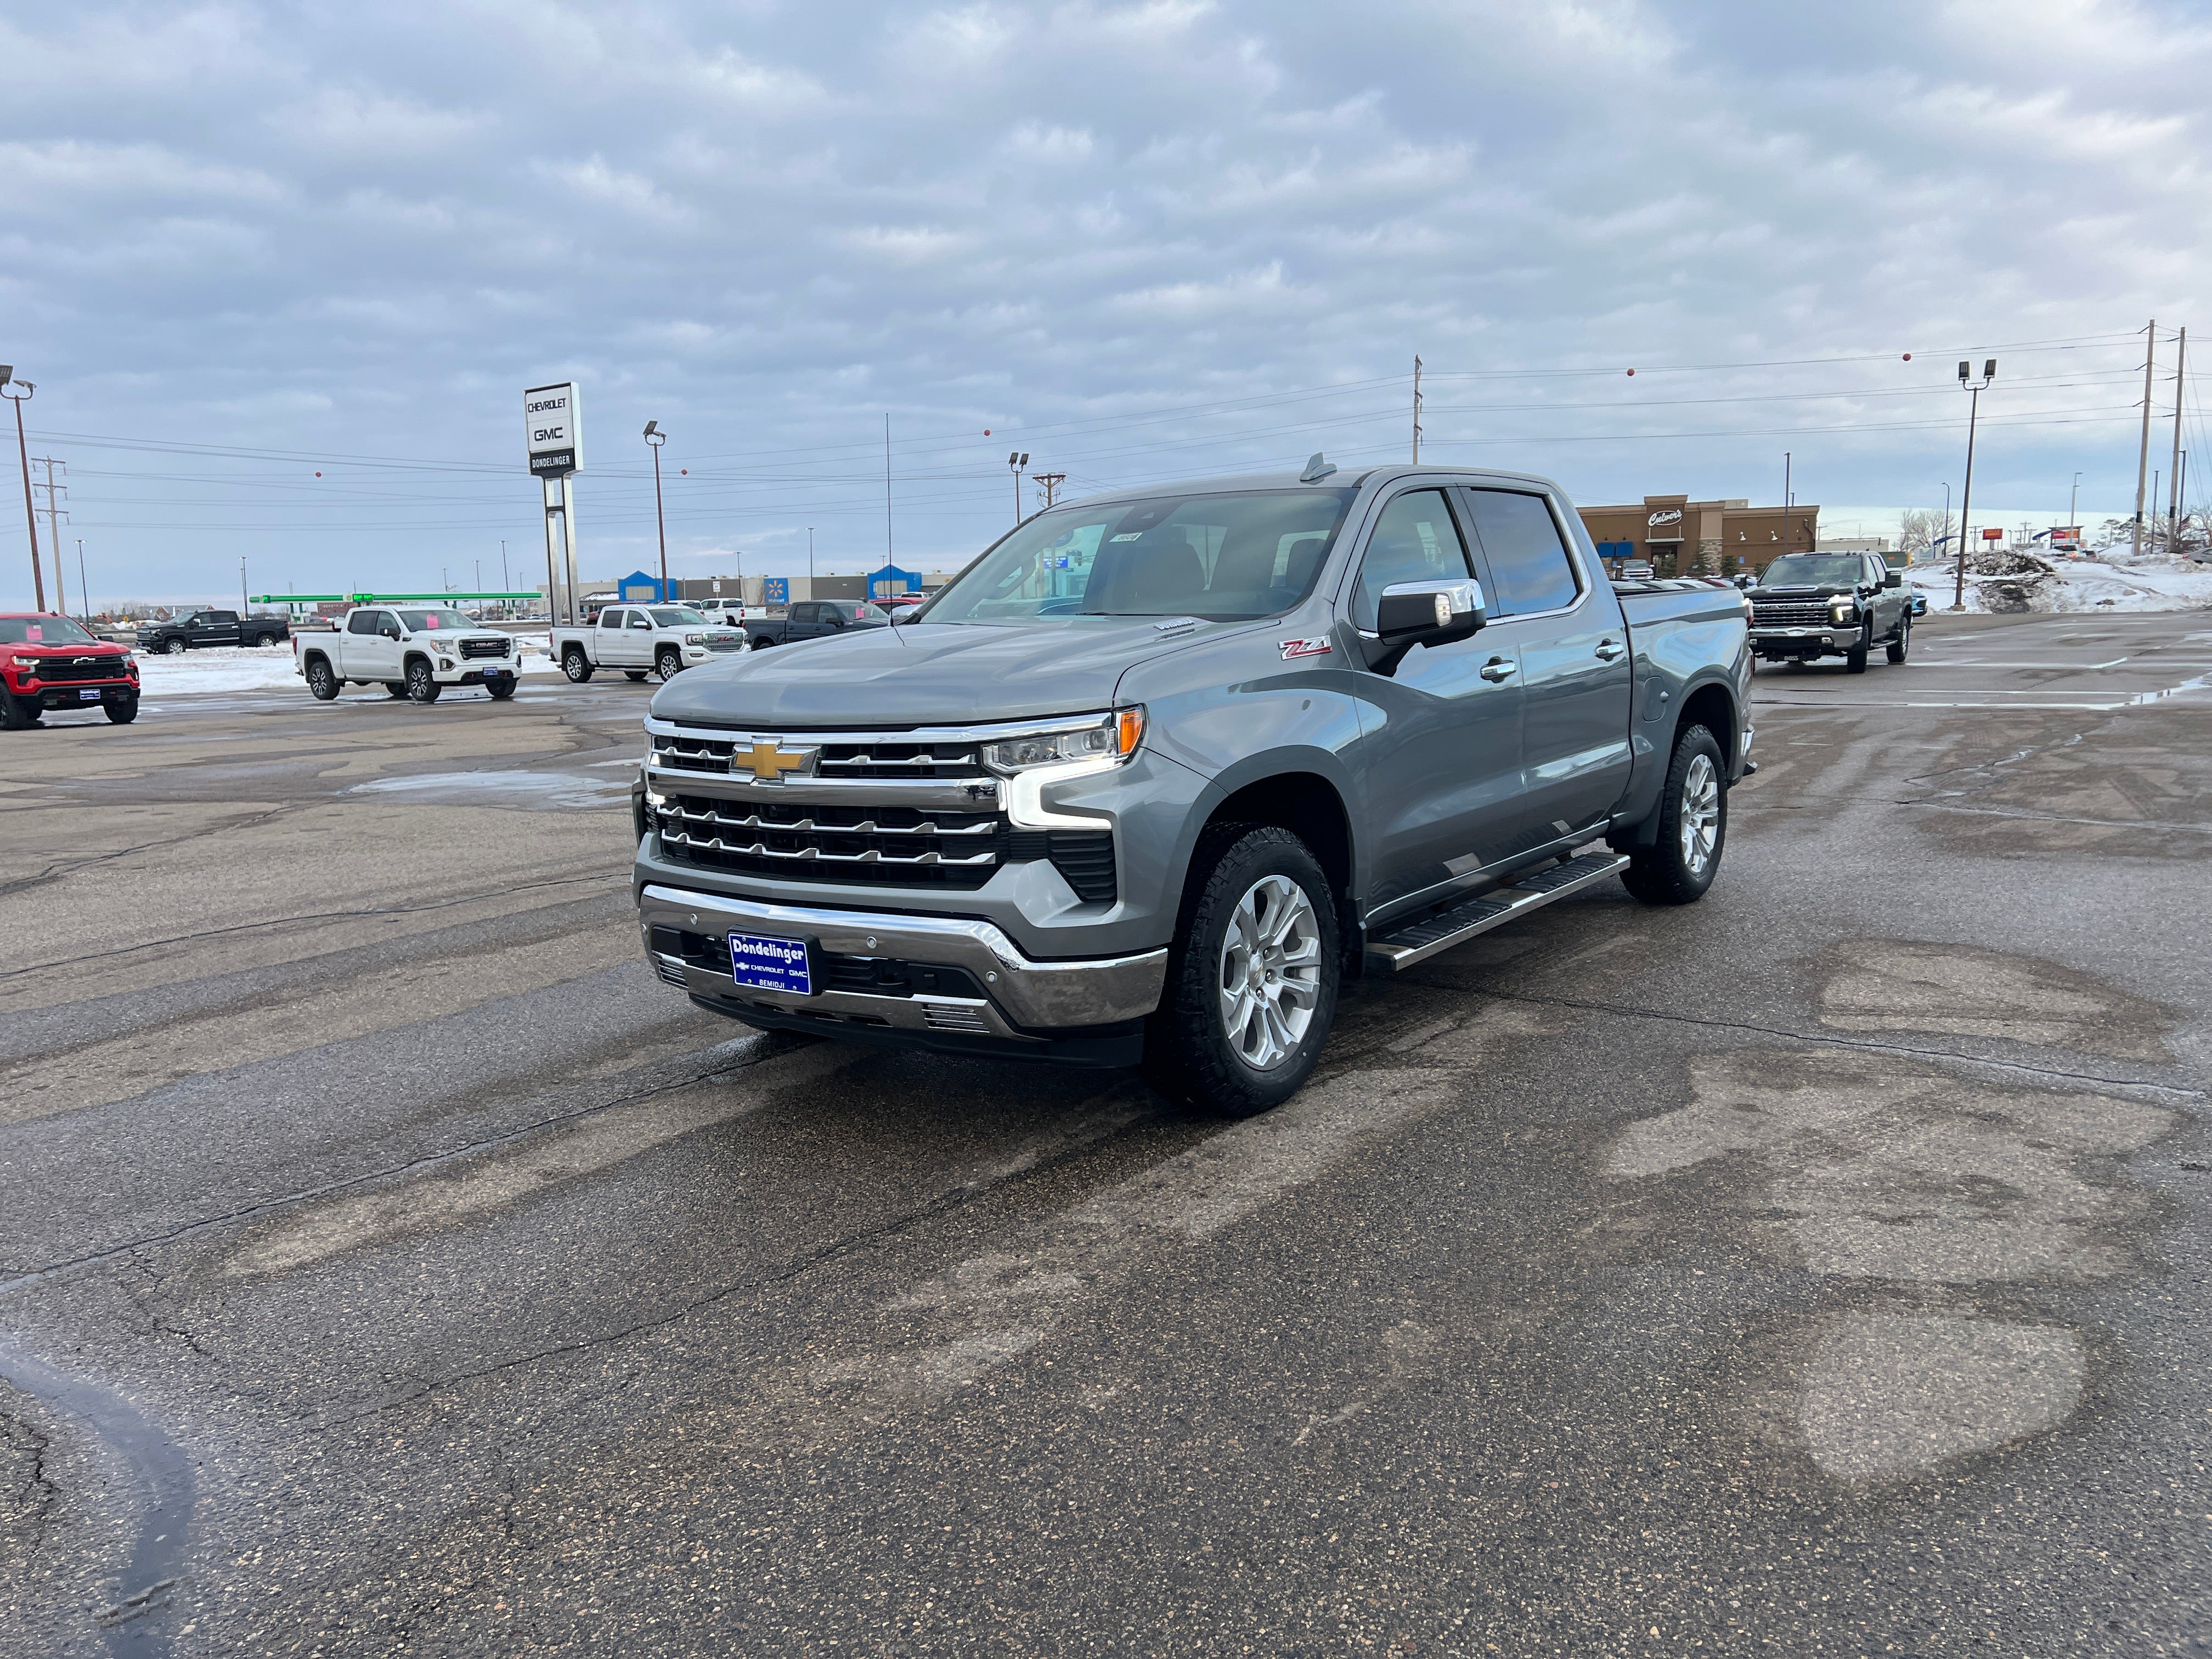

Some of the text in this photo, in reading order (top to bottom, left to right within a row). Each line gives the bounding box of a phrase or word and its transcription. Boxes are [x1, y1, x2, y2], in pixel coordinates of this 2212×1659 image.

[528, 398, 566, 413] CHEVROLET
[534, 427, 563, 441] GMC
[532, 455, 570, 468] DONDELINGER
[1648, 509, 1683, 526] Culver's
[1278, 635, 1333, 661] Z71
[732, 939, 804, 964] Dondelinger
[751, 964, 808, 978] CHEVROLET GMC
[759, 979, 785, 989] BEMIDJI
